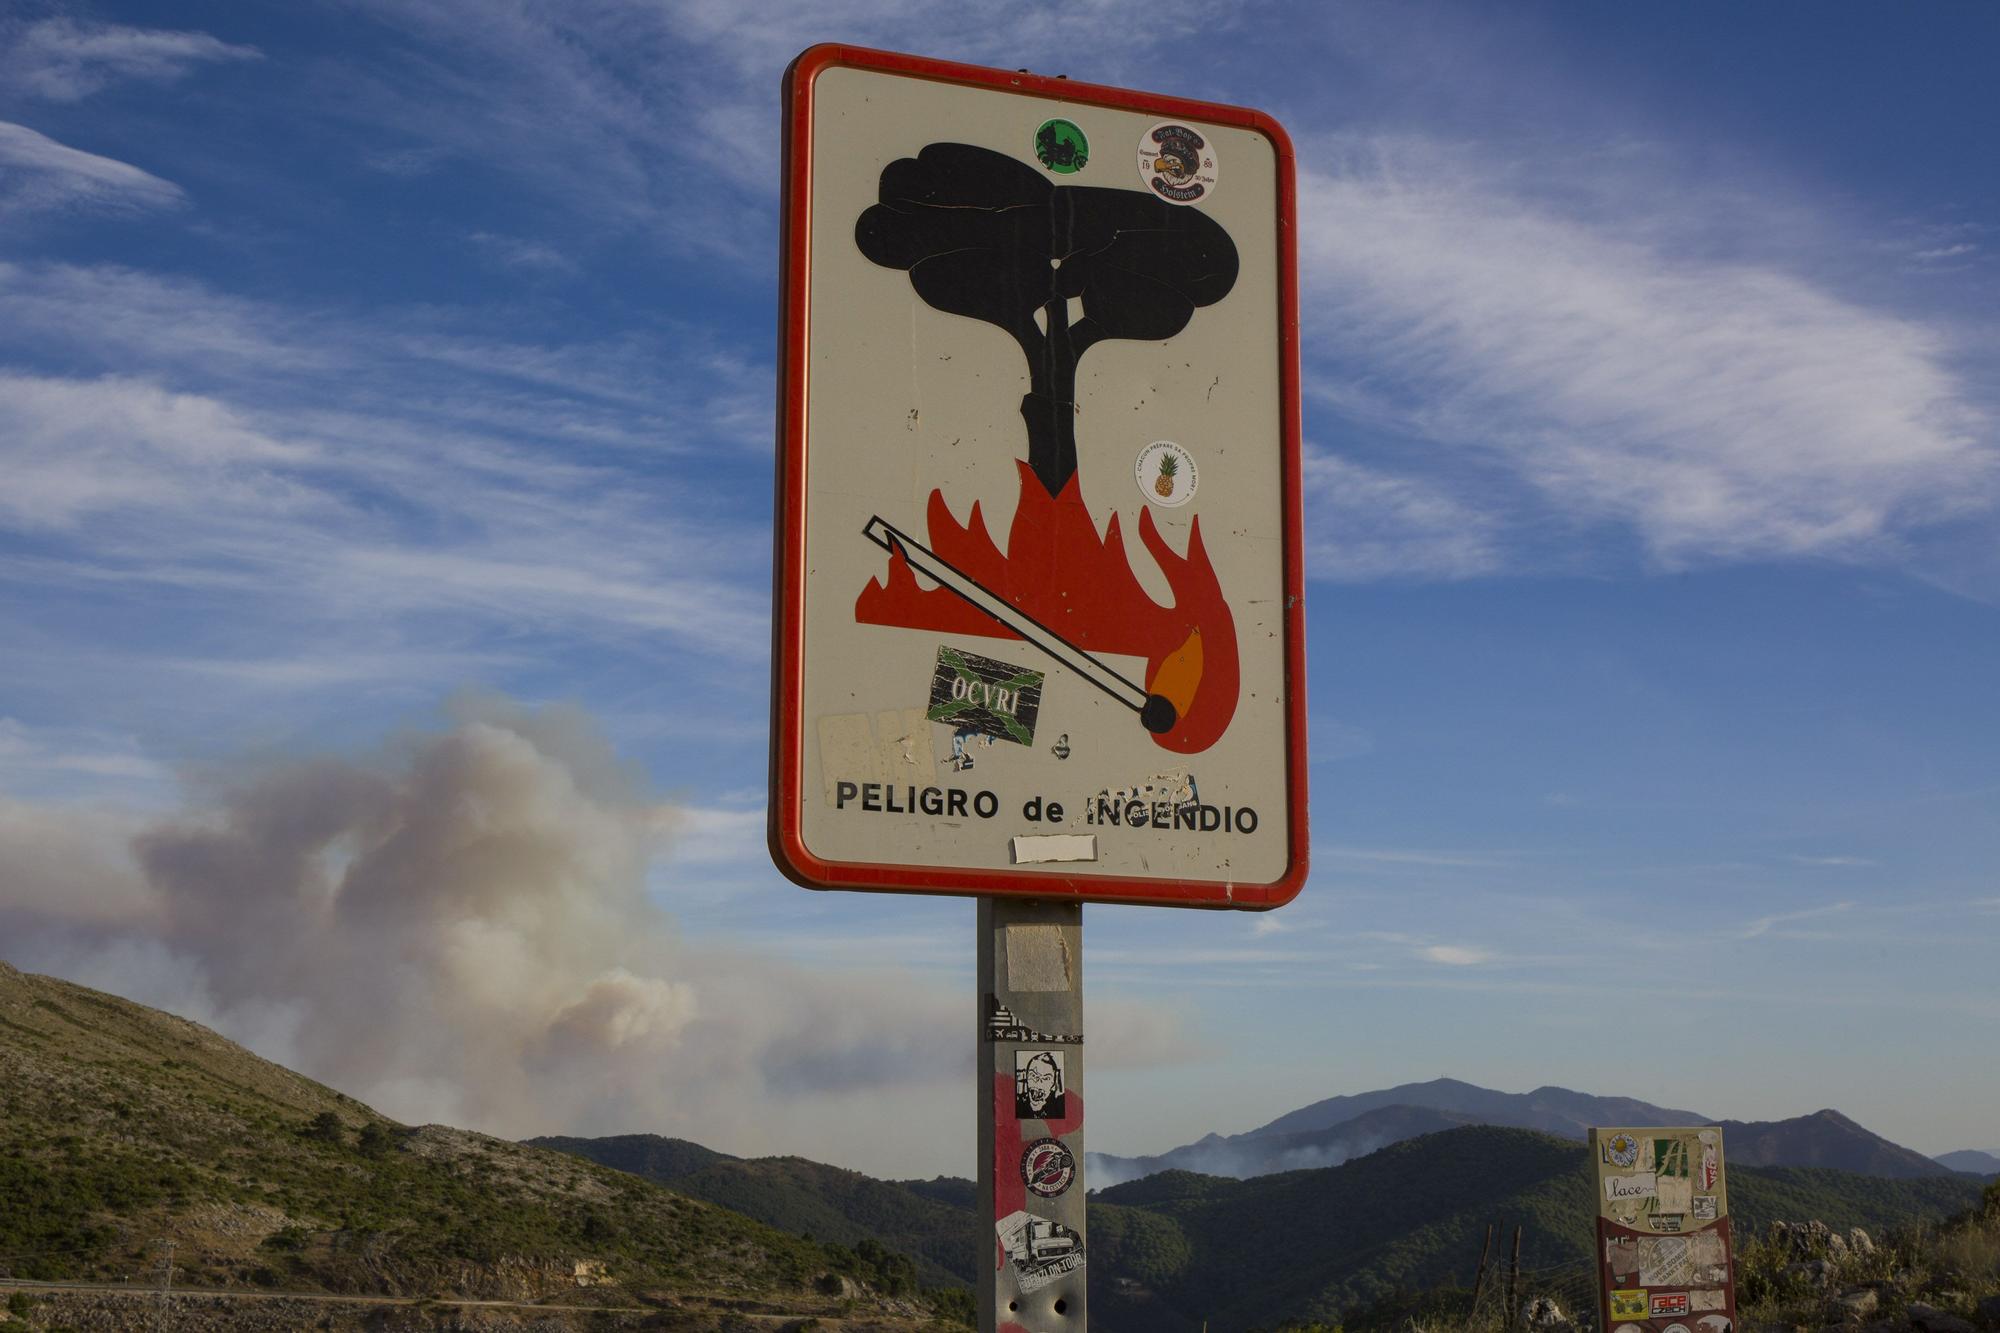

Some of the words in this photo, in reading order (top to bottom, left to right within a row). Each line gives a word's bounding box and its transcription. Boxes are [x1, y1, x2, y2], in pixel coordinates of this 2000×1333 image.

[836, 781, 999, 819] PELIGRO
[1023, 795, 1064, 823] de
[1086, 797, 1258, 835] INCENDIO
[1048, 1263, 1062, 1277] ON
[1060, 1253, 1083, 1271] TOUR
